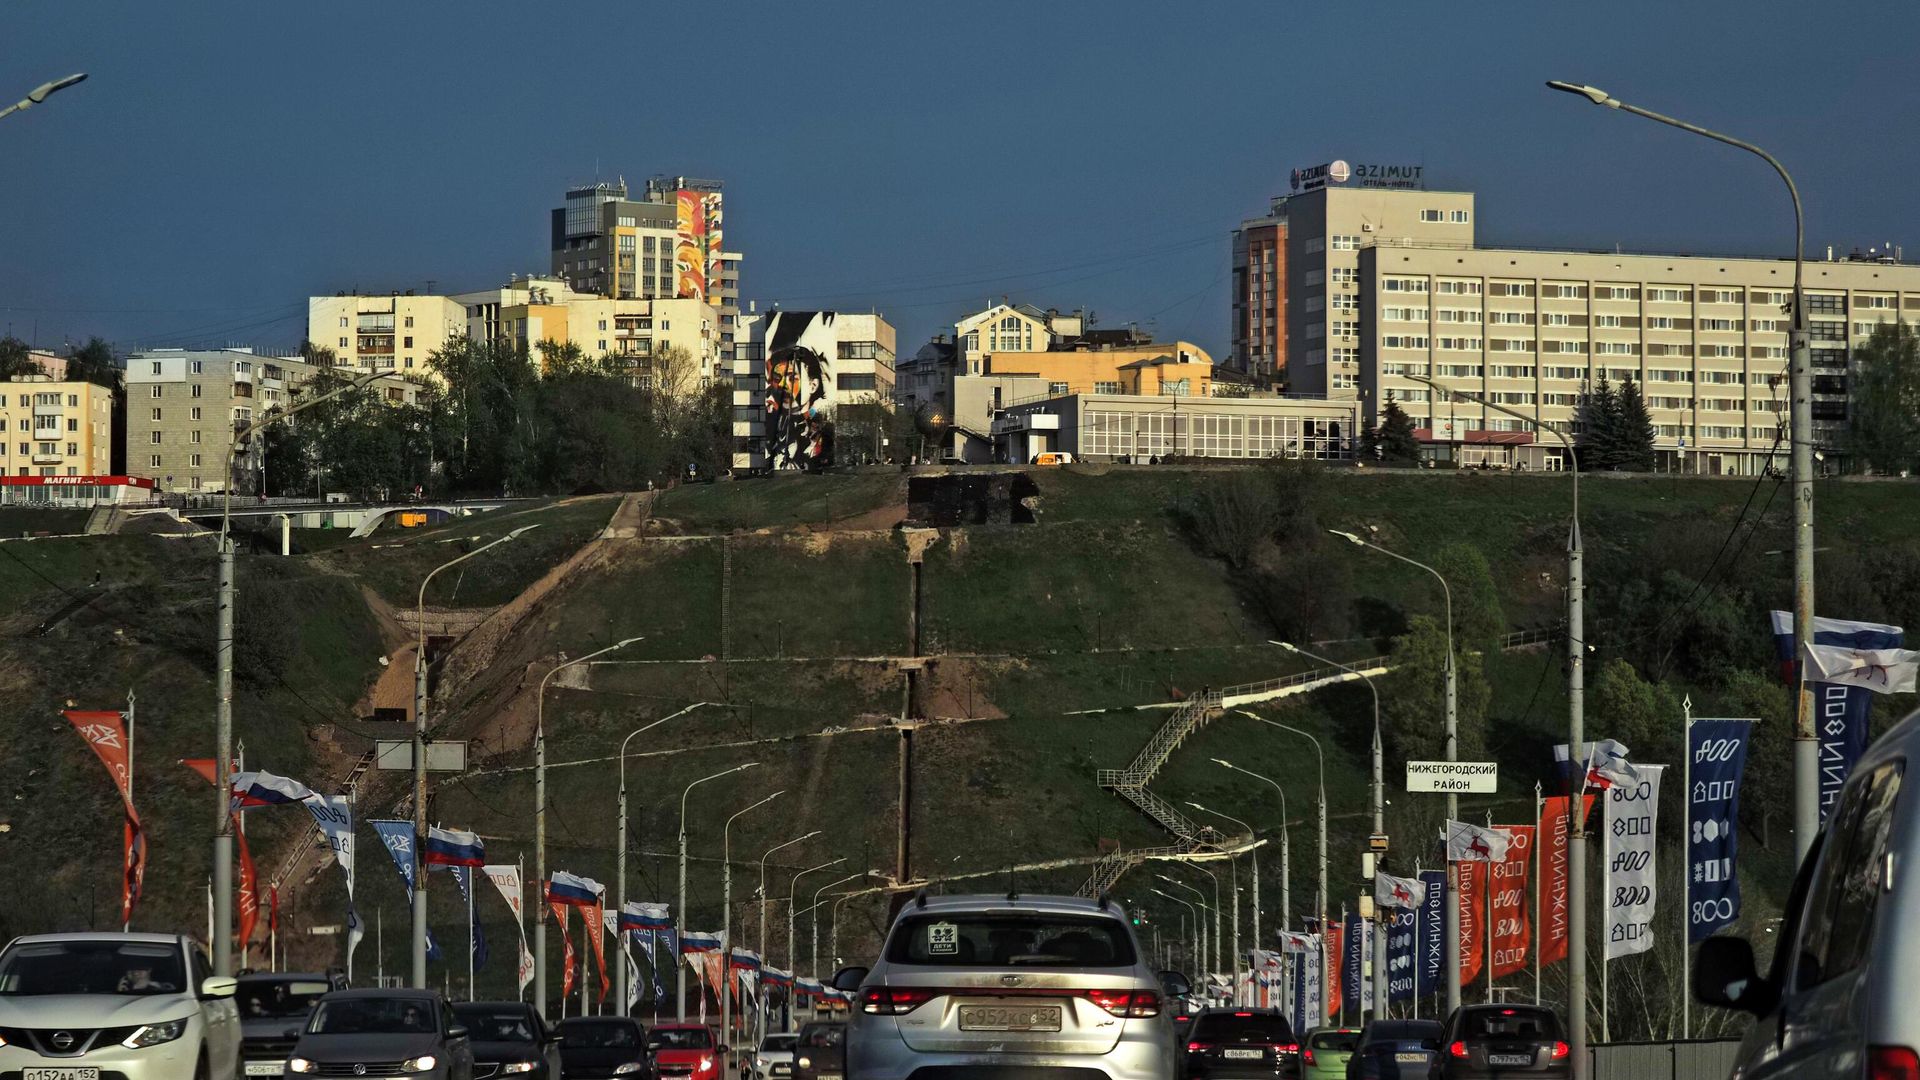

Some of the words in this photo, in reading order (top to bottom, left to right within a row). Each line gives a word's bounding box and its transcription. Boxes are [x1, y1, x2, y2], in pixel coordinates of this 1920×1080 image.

[1408, 765, 1496, 775] НИЖЕГОРОДСКИЙ
[1434, 779, 1470, 789] РАЙОН
[1550, 852, 1565, 940] НИЖНИЙ
[1692, 897, 1733, 924] 800
[1427, 910, 1441, 978] НИЖНИЙ
[77, 1069, 96, 1078] 152
